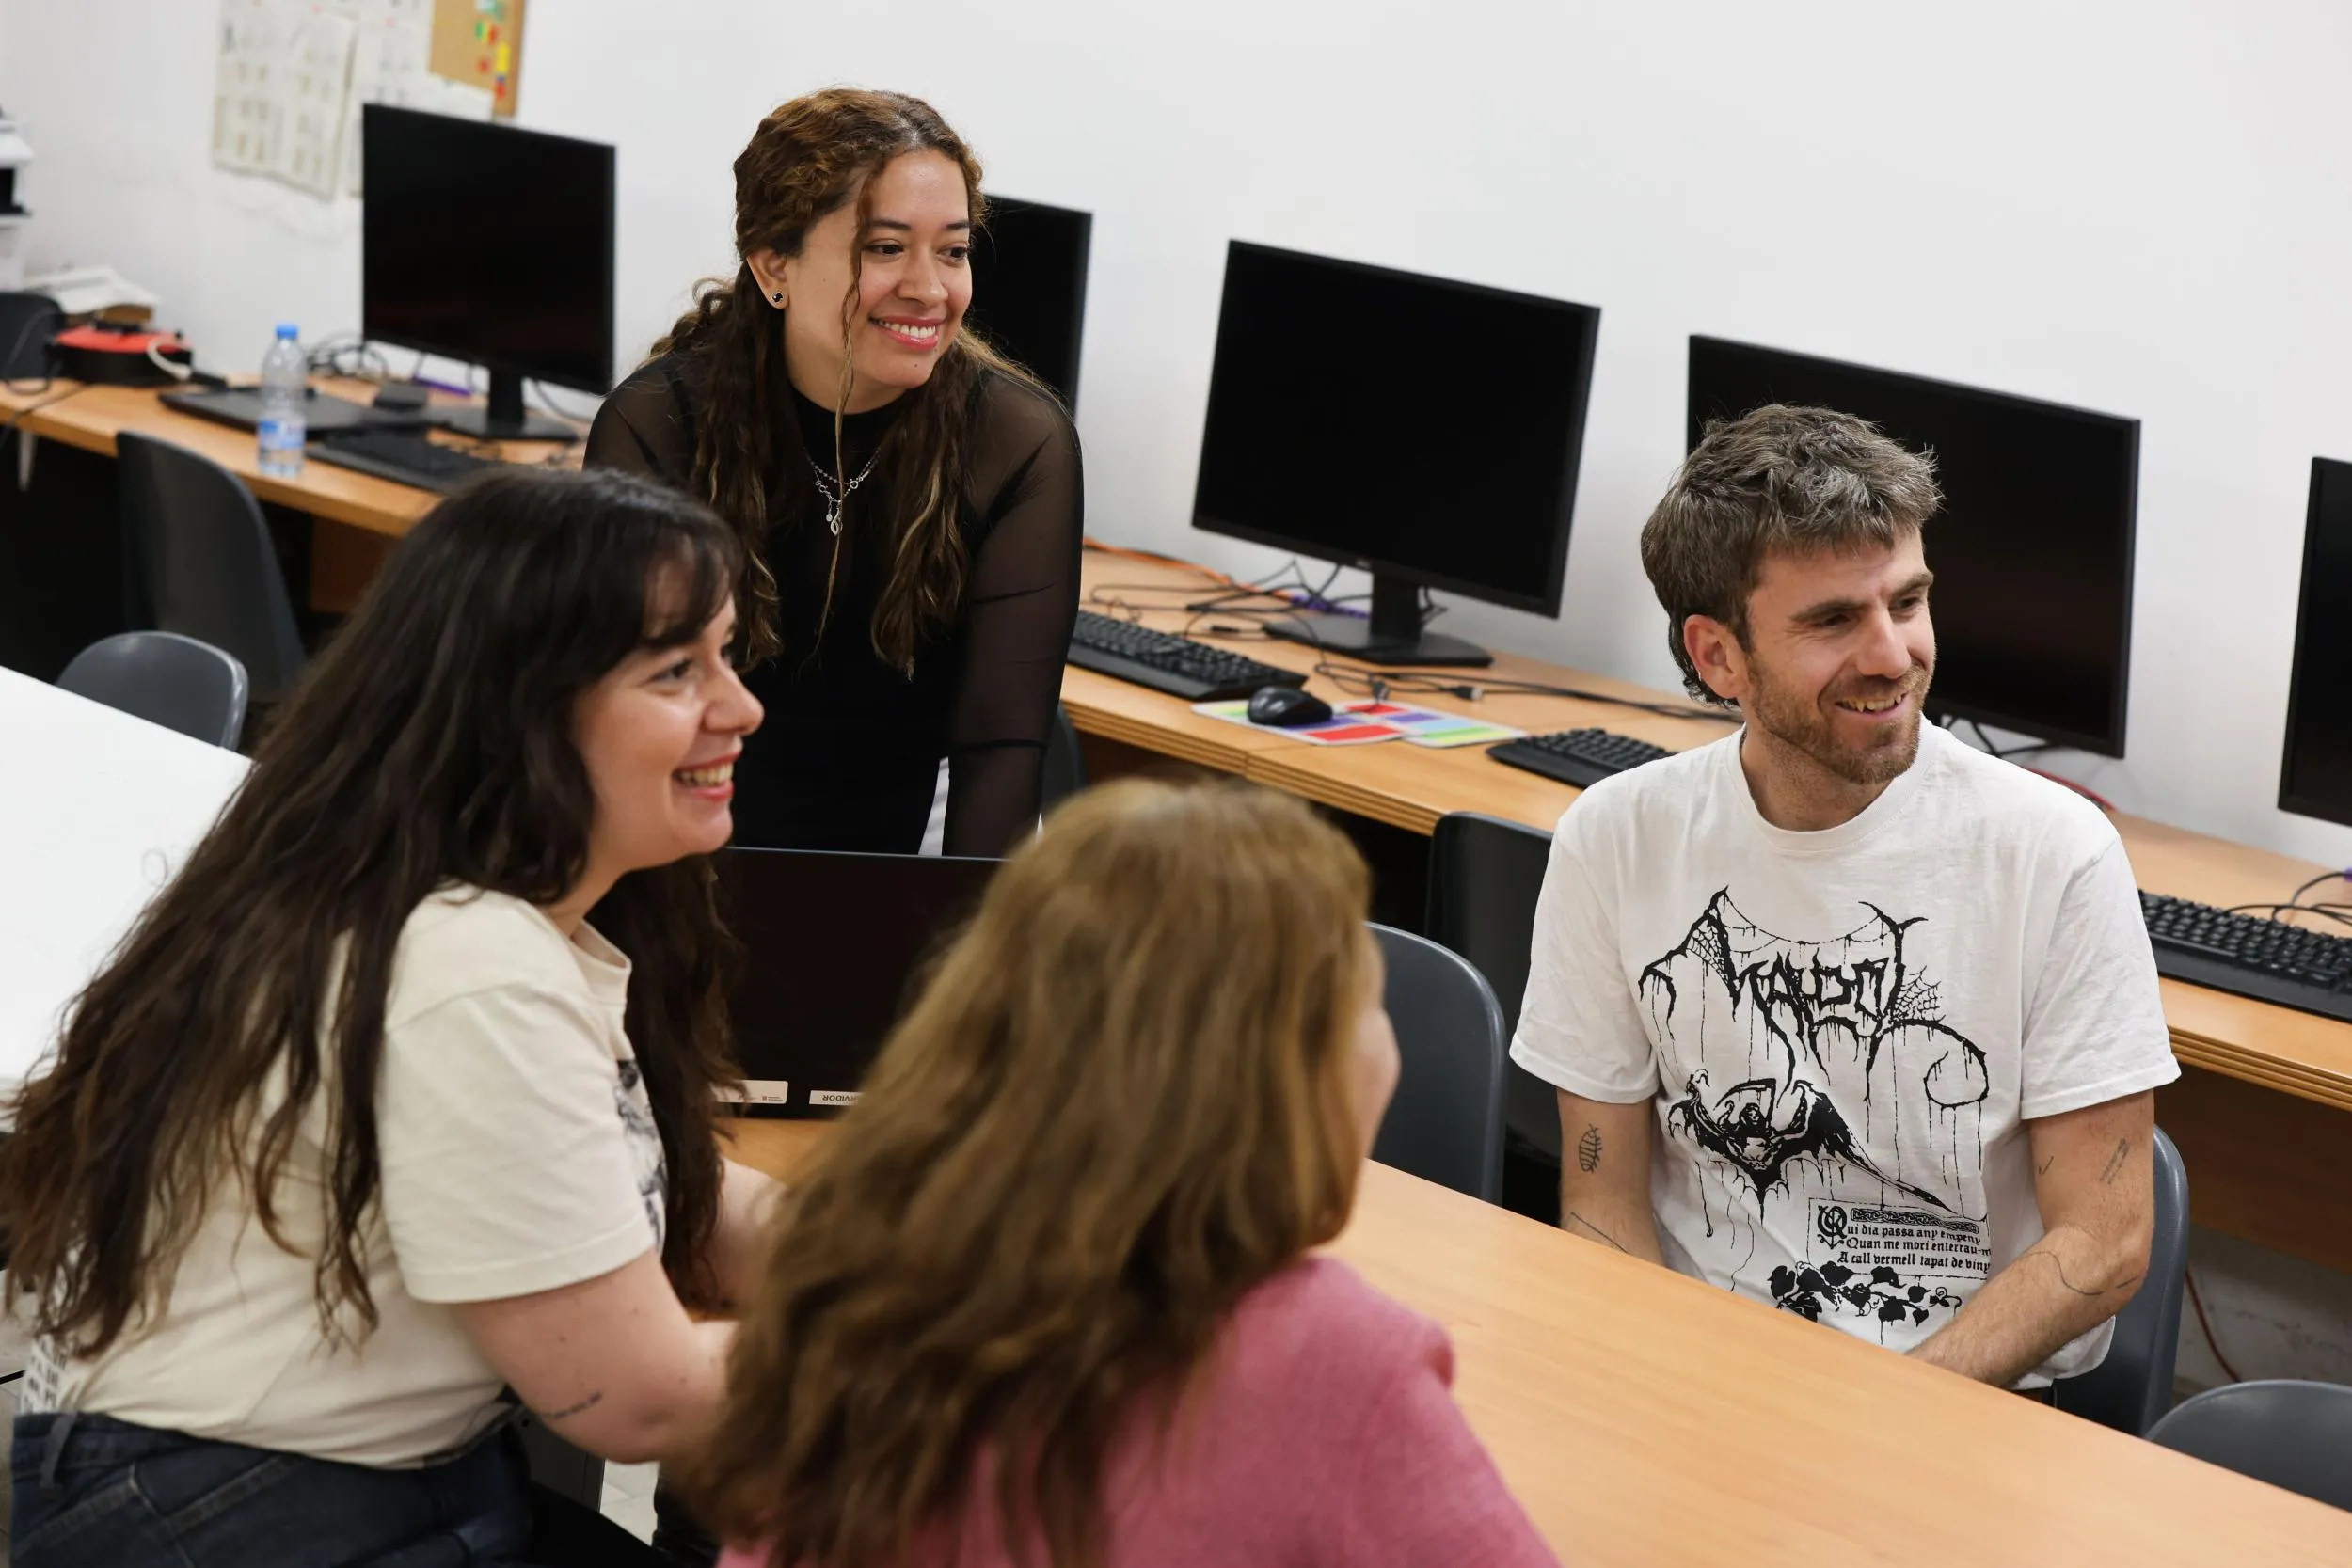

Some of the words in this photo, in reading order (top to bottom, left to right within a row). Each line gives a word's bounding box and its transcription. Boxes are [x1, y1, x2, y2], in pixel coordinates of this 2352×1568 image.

[1817, 1205, 1859, 1250] Qui
[1861, 1224, 1879, 1236] dia
[1882, 1227, 1915, 1238] passa
[1916, 1228, 1938, 1241] any
[1940, 1230, 1981, 1246] empeny
[1846, 1236, 1881, 1250] Quan
[1883, 1240, 1900, 1250] me
[1931, 1241, 1992, 1258] enterrau-m
[1837, 1251, 1849, 1264] A
[1851, 1252, 1871, 1265] call
[1873, 1253, 1916, 1265] vermell
[1920, 1255, 1948, 1269] tapat
[1951, 1256, 1963, 1268] de
[1965, 1258, 1992, 1275] viny
